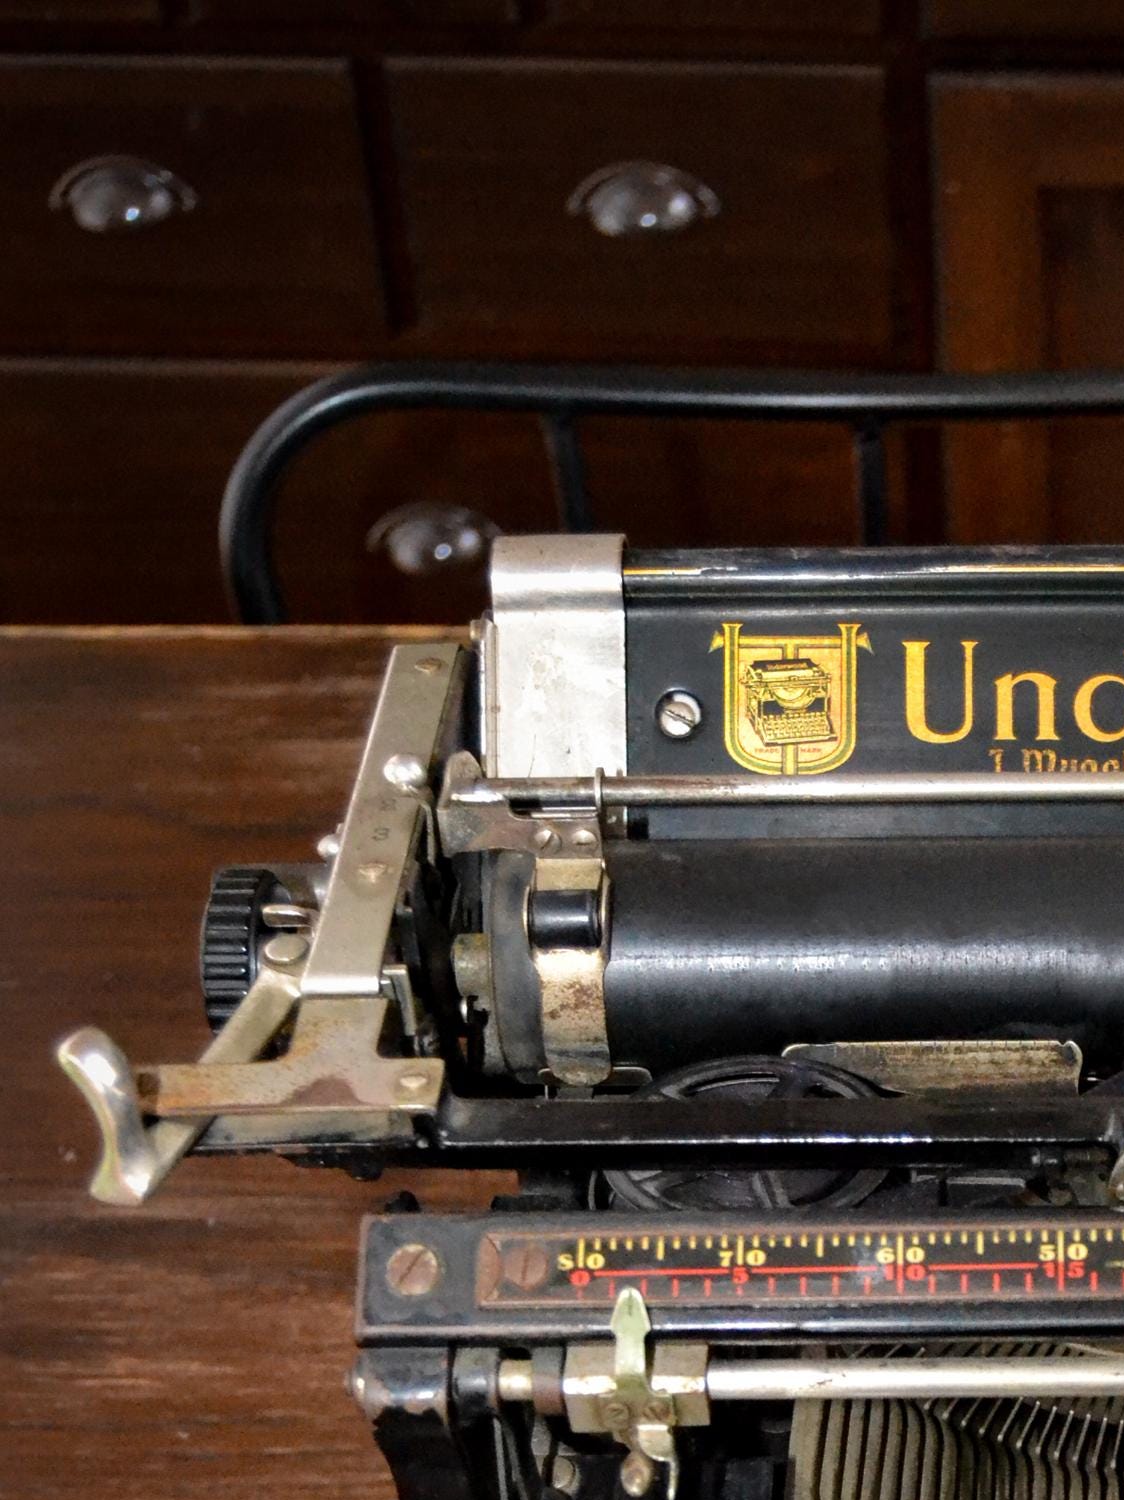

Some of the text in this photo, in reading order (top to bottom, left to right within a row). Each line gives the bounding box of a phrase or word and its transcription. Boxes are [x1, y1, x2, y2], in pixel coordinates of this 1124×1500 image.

[718, 1249, 766, 1267] 70
[876, 1246, 925, 1265] 60
[1038, 1243, 1088, 1262] 50
